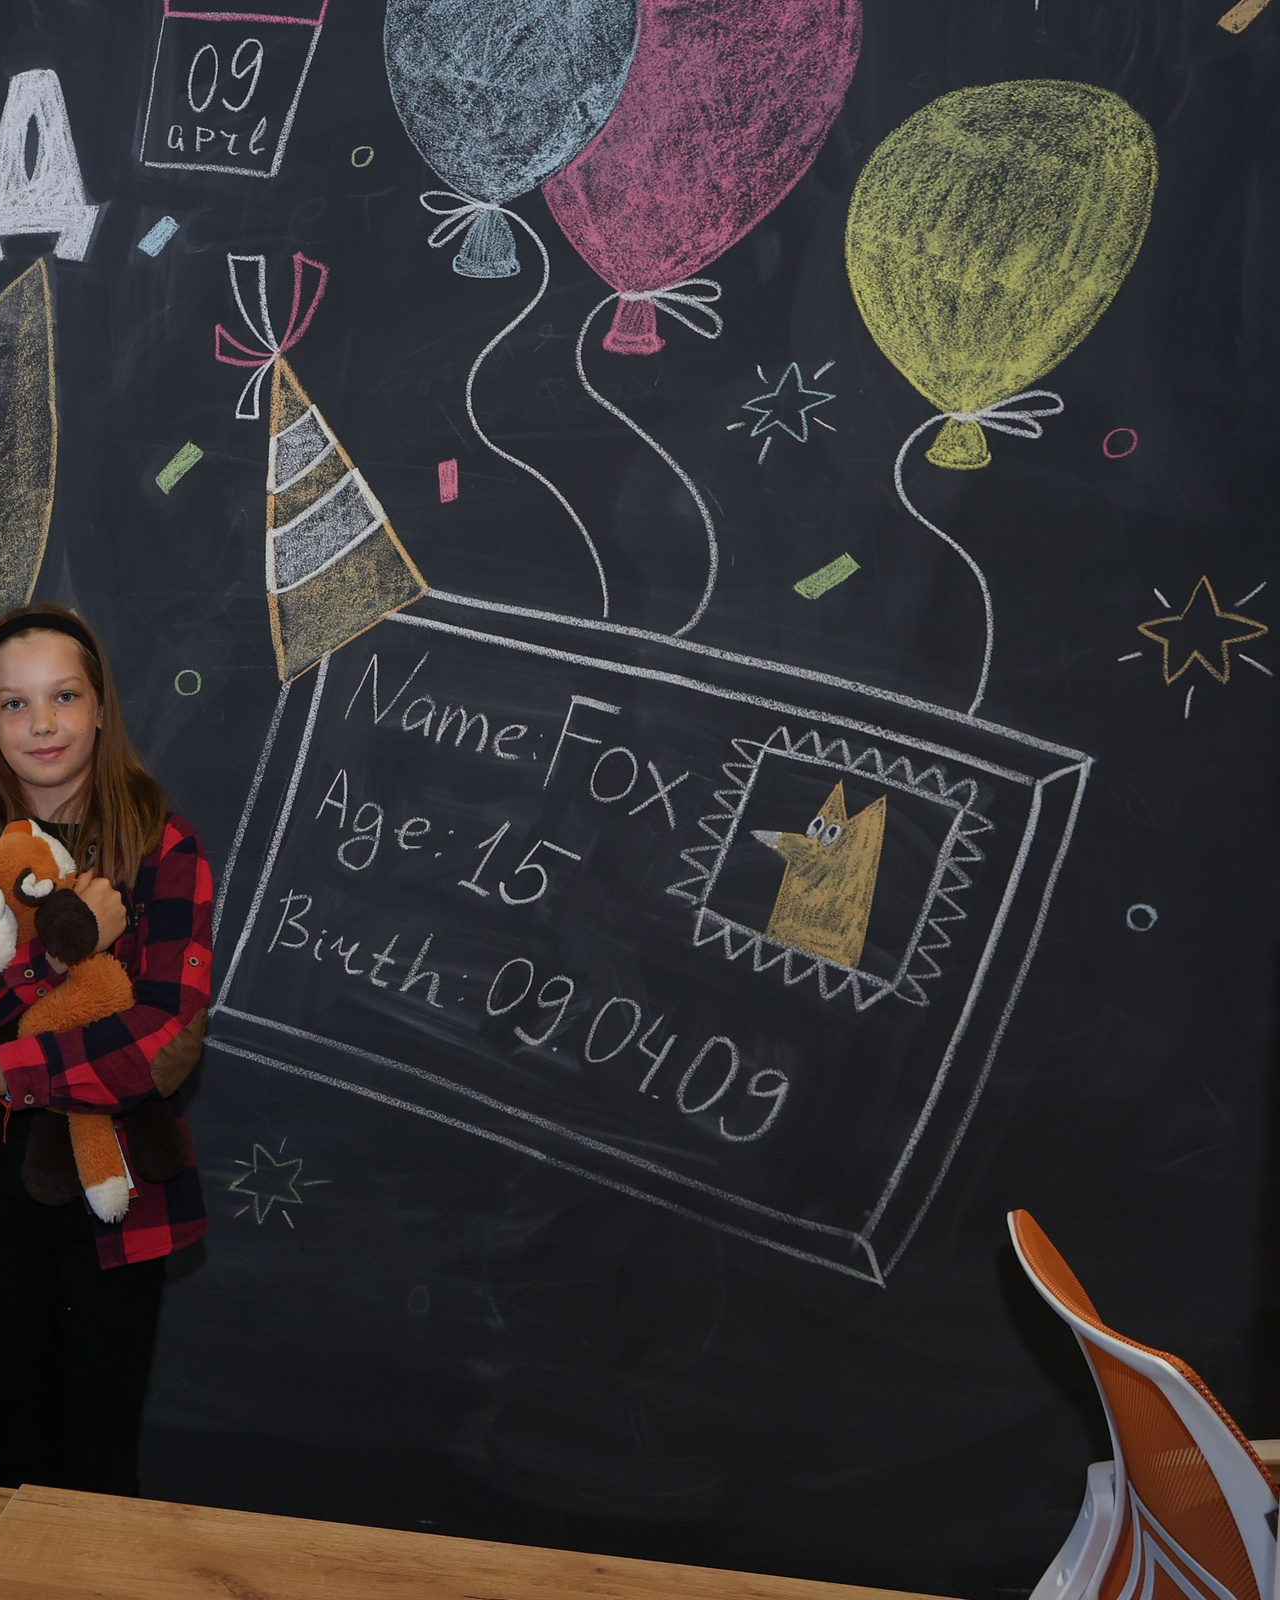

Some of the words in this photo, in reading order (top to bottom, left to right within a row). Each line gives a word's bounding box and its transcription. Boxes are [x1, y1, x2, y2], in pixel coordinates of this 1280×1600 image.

[187, 38, 264, 113] 09
[344, 651, 545, 762] Name:
[542, 694, 691, 829] Fox
[315, 768, 455, 871] Age:
[457, 820, 582, 906] 15
[267, 888, 467, 1010] Birth:
[486, 957, 790, 1143] 09.04.09
